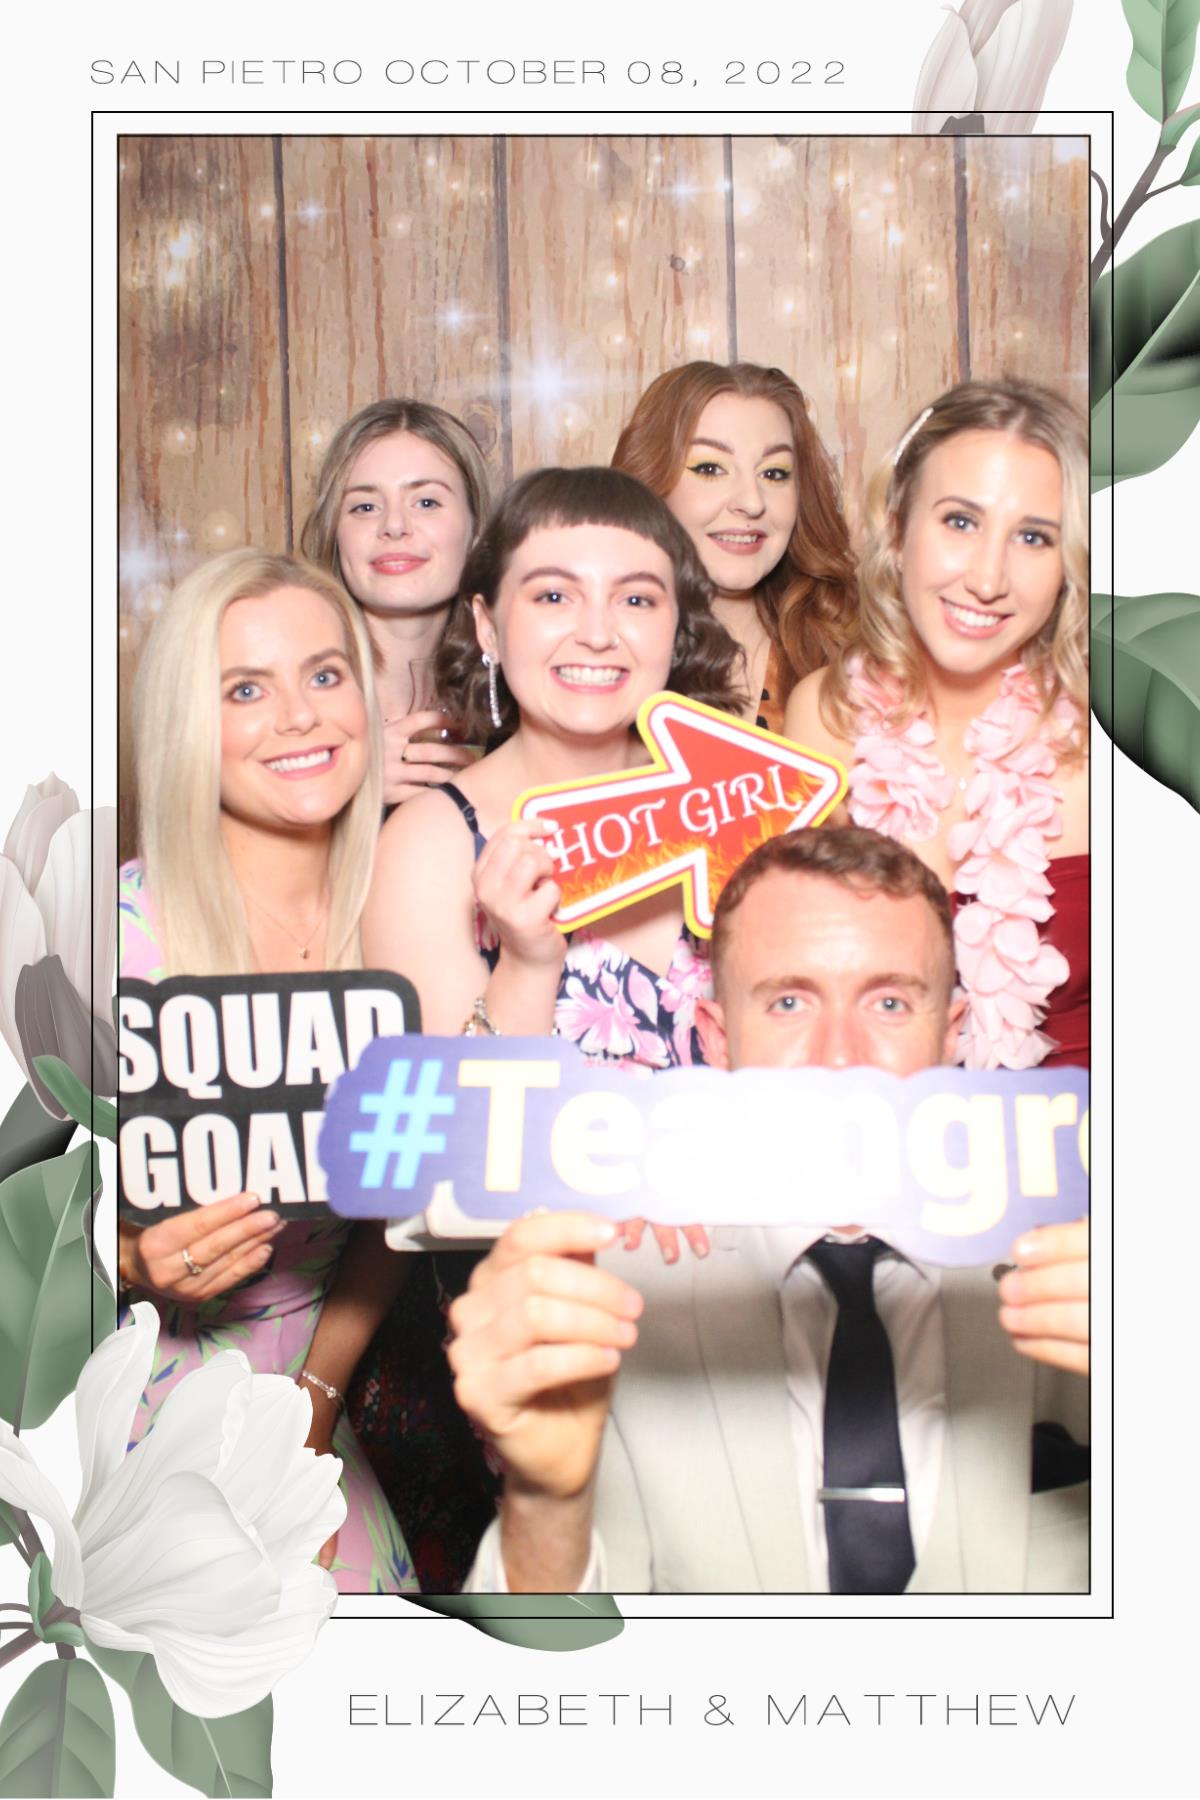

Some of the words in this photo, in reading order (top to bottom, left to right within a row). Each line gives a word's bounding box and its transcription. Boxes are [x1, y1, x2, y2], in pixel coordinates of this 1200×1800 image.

[552, 800, 665, 873] HOT
[679, 765, 803, 838] GIRL
[349, 1059, 1090, 1236] #Teamgr
